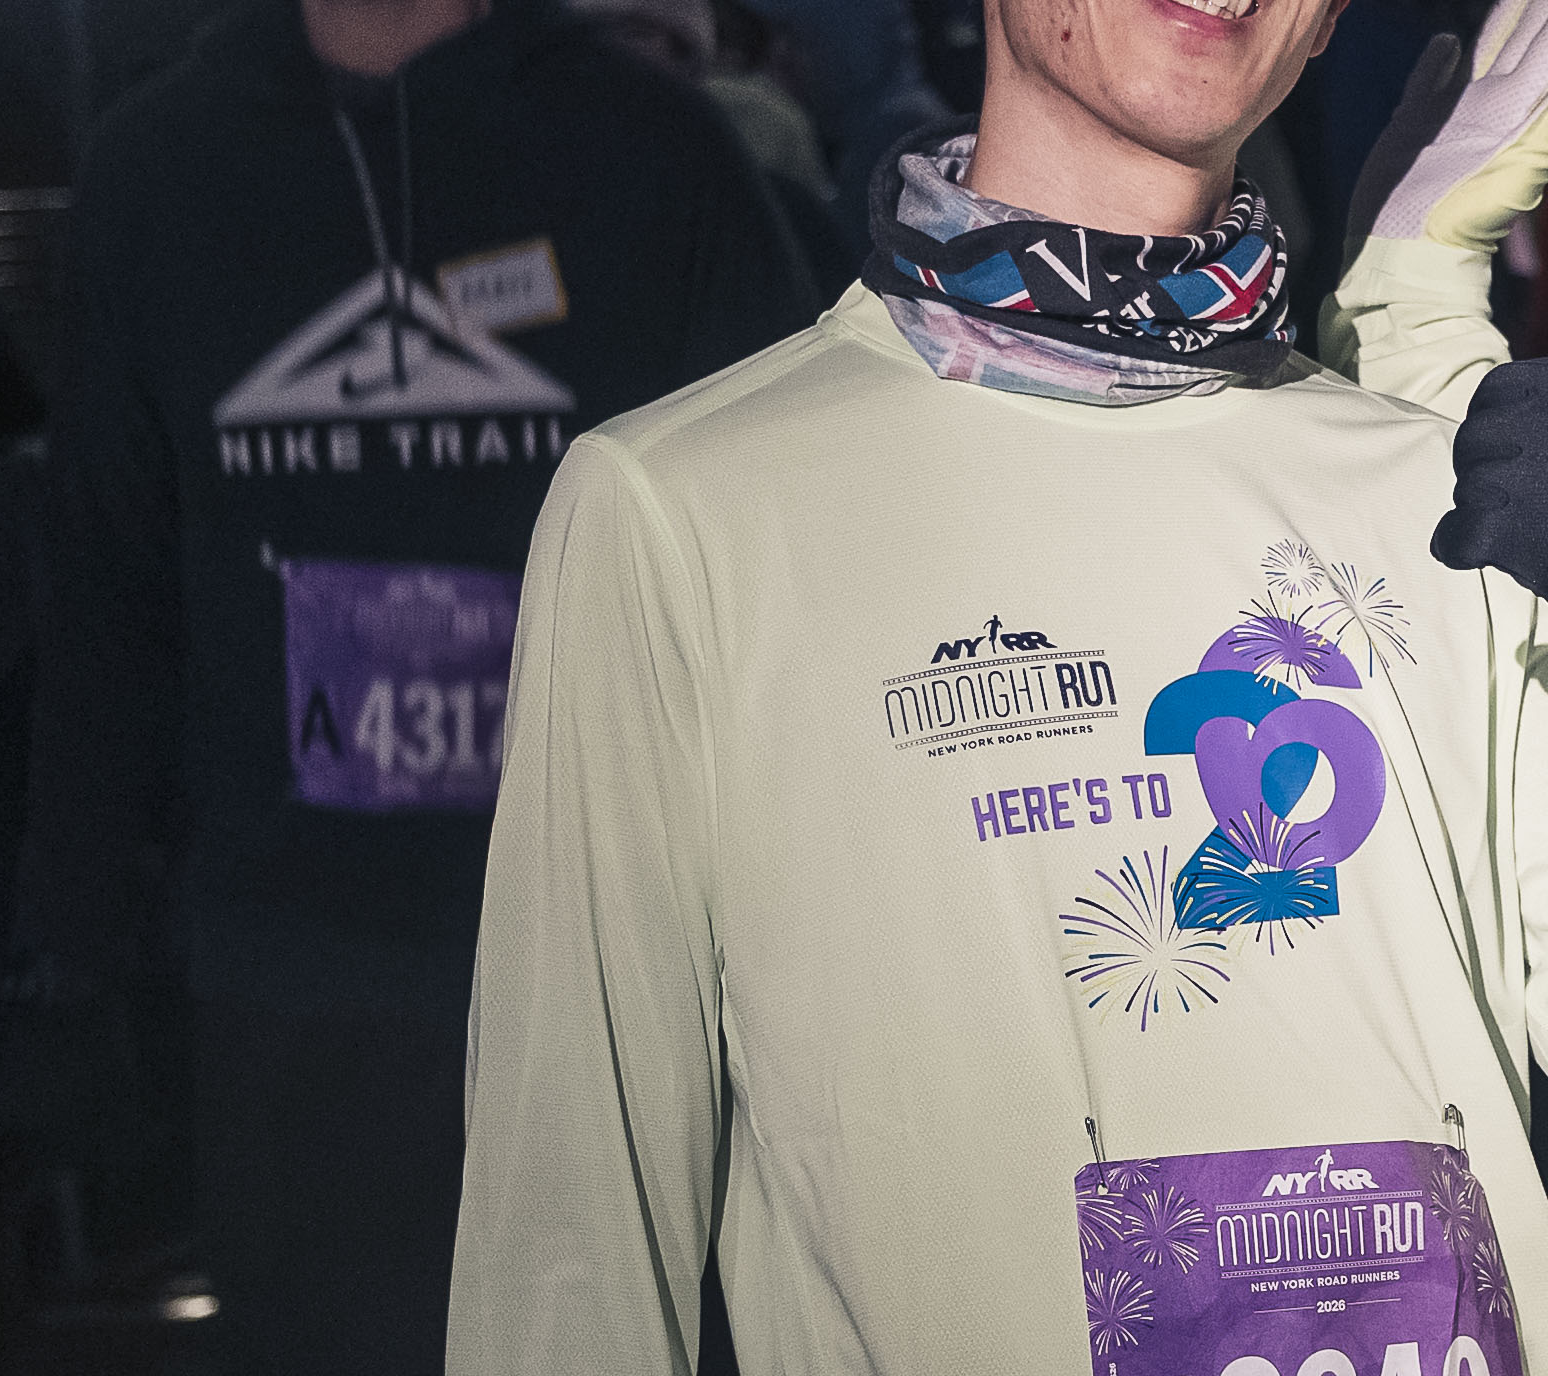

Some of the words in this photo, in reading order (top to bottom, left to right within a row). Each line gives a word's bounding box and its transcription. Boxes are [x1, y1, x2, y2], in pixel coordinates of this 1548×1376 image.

[884, 666, 1049, 739] MIDNIGHT
[1055, 660, 1118, 710] RUN
[927, 743, 958, 758] NEW
[960, 736, 995, 751] YORK
[997, 731, 1033, 745] ROAD
[1036, 724, 1094, 740] RUNNERS
[970, 777, 1112, 842] HERE'S
[1122, 773, 1173, 819] TO
[1215, 1205, 1368, 1268] MIDNIGHT
[1372, 1200, 1426, 1255] RUN
[1250, 1281, 1280, 1293] NEW
[1281, 1277, 1316, 1290] YORK
[1317, 1274, 1349, 1287] ROAD
[1350, 1270, 1401, 1284] RUNNERS
[1316, 1299, 1347, 1314] 2026
